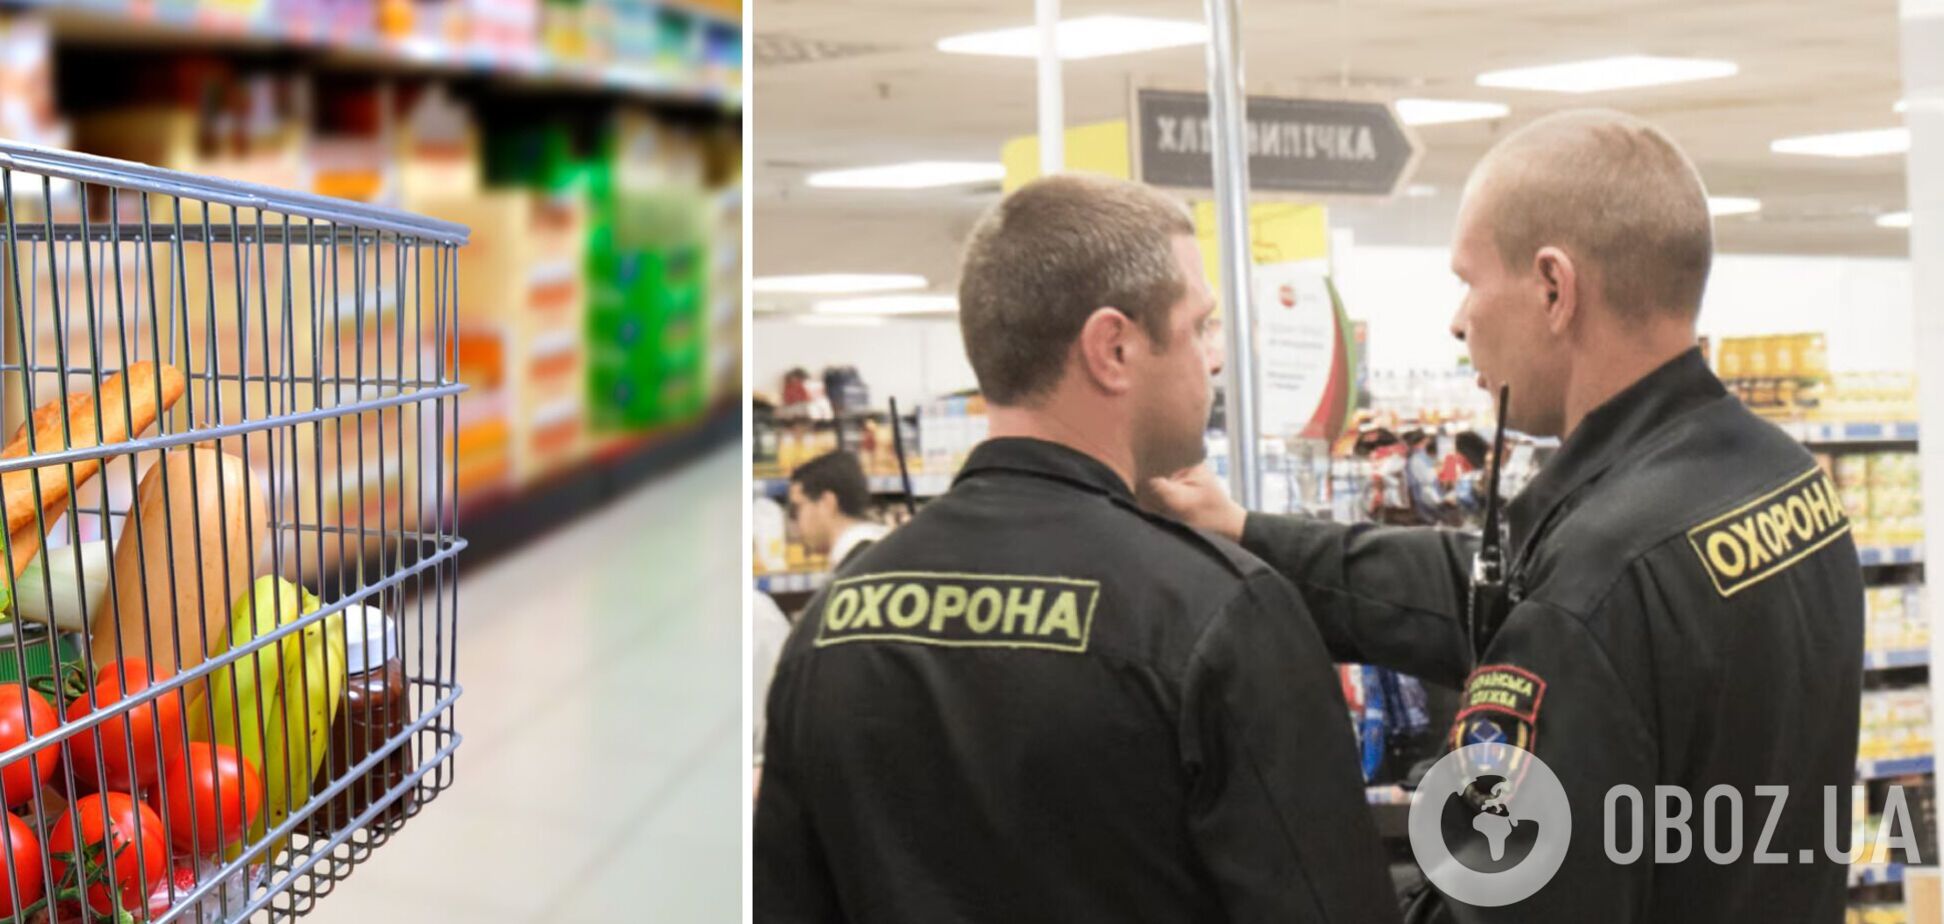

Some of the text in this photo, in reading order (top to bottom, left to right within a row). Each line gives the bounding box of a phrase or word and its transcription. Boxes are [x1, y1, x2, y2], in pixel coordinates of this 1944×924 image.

[1157, 116, 1213, 153] ХЛІ
[1706, 475, 1844, 577] ОХОРОНА
[825, 583, 1082, 640] ОХОРОНА
